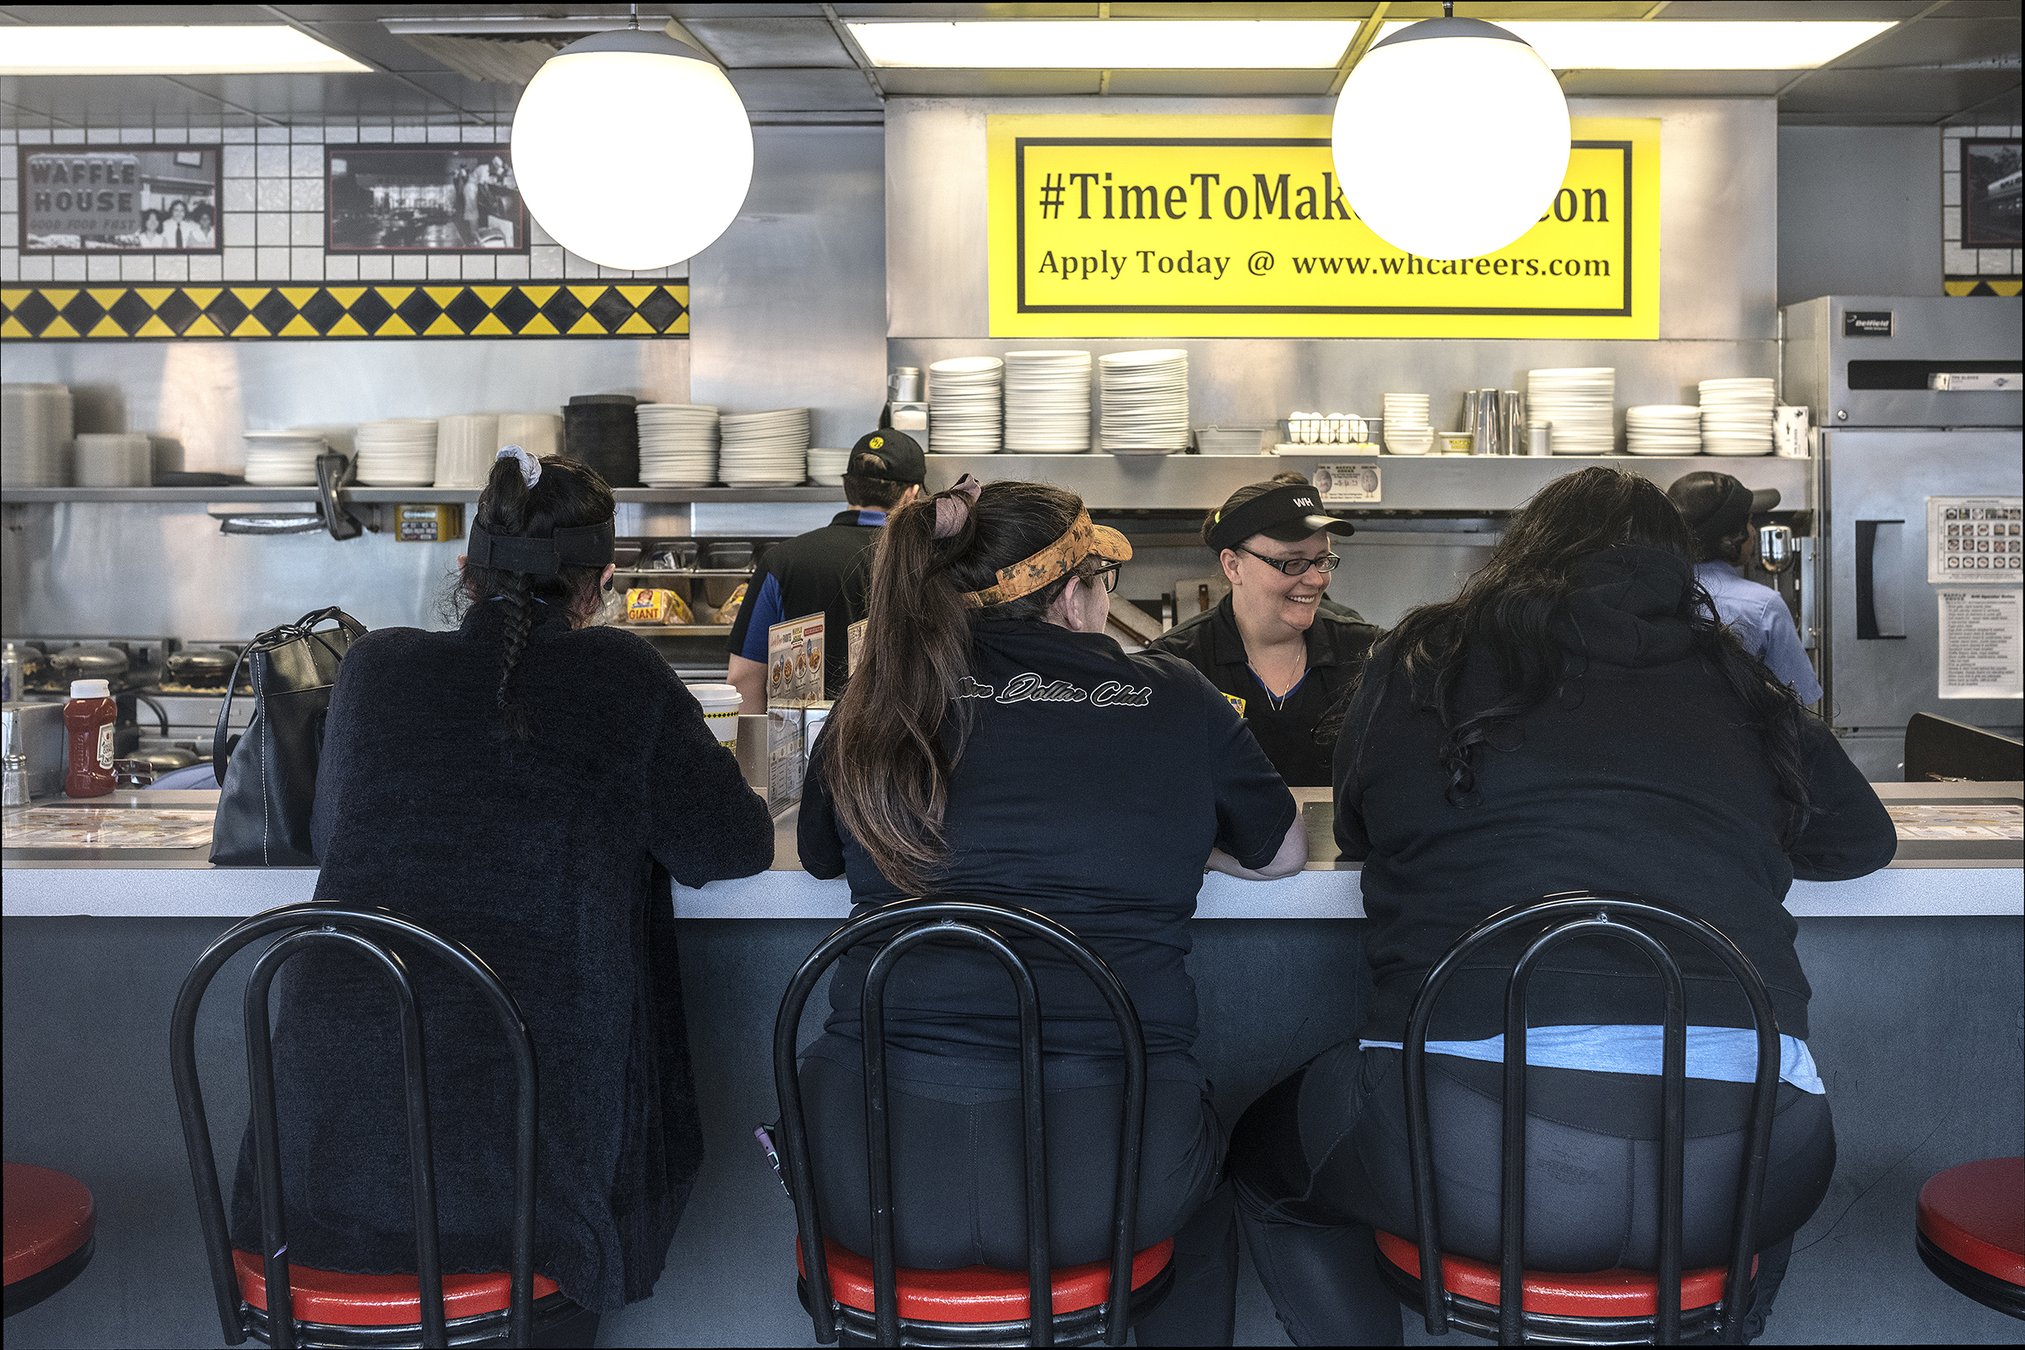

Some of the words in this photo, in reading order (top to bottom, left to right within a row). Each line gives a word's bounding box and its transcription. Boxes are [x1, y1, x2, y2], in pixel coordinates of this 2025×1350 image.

[31, 161, 135, 184] WAFFLE
[35, 190, 133, 212] HOUSE
[1038, 250, 1127, 280] Apply
[1136, 250, 1231, 280] Today
[1247, 250, 1275, 276] @
[1292, 251, 1611, 277] www.whcareers.com
[1293, 498, 1314, 508] WH
[628, 608, 659, 620] GIANT
[995, 672, 1088, 704] Dollar
[1090, 680, 1153, 707] Club
